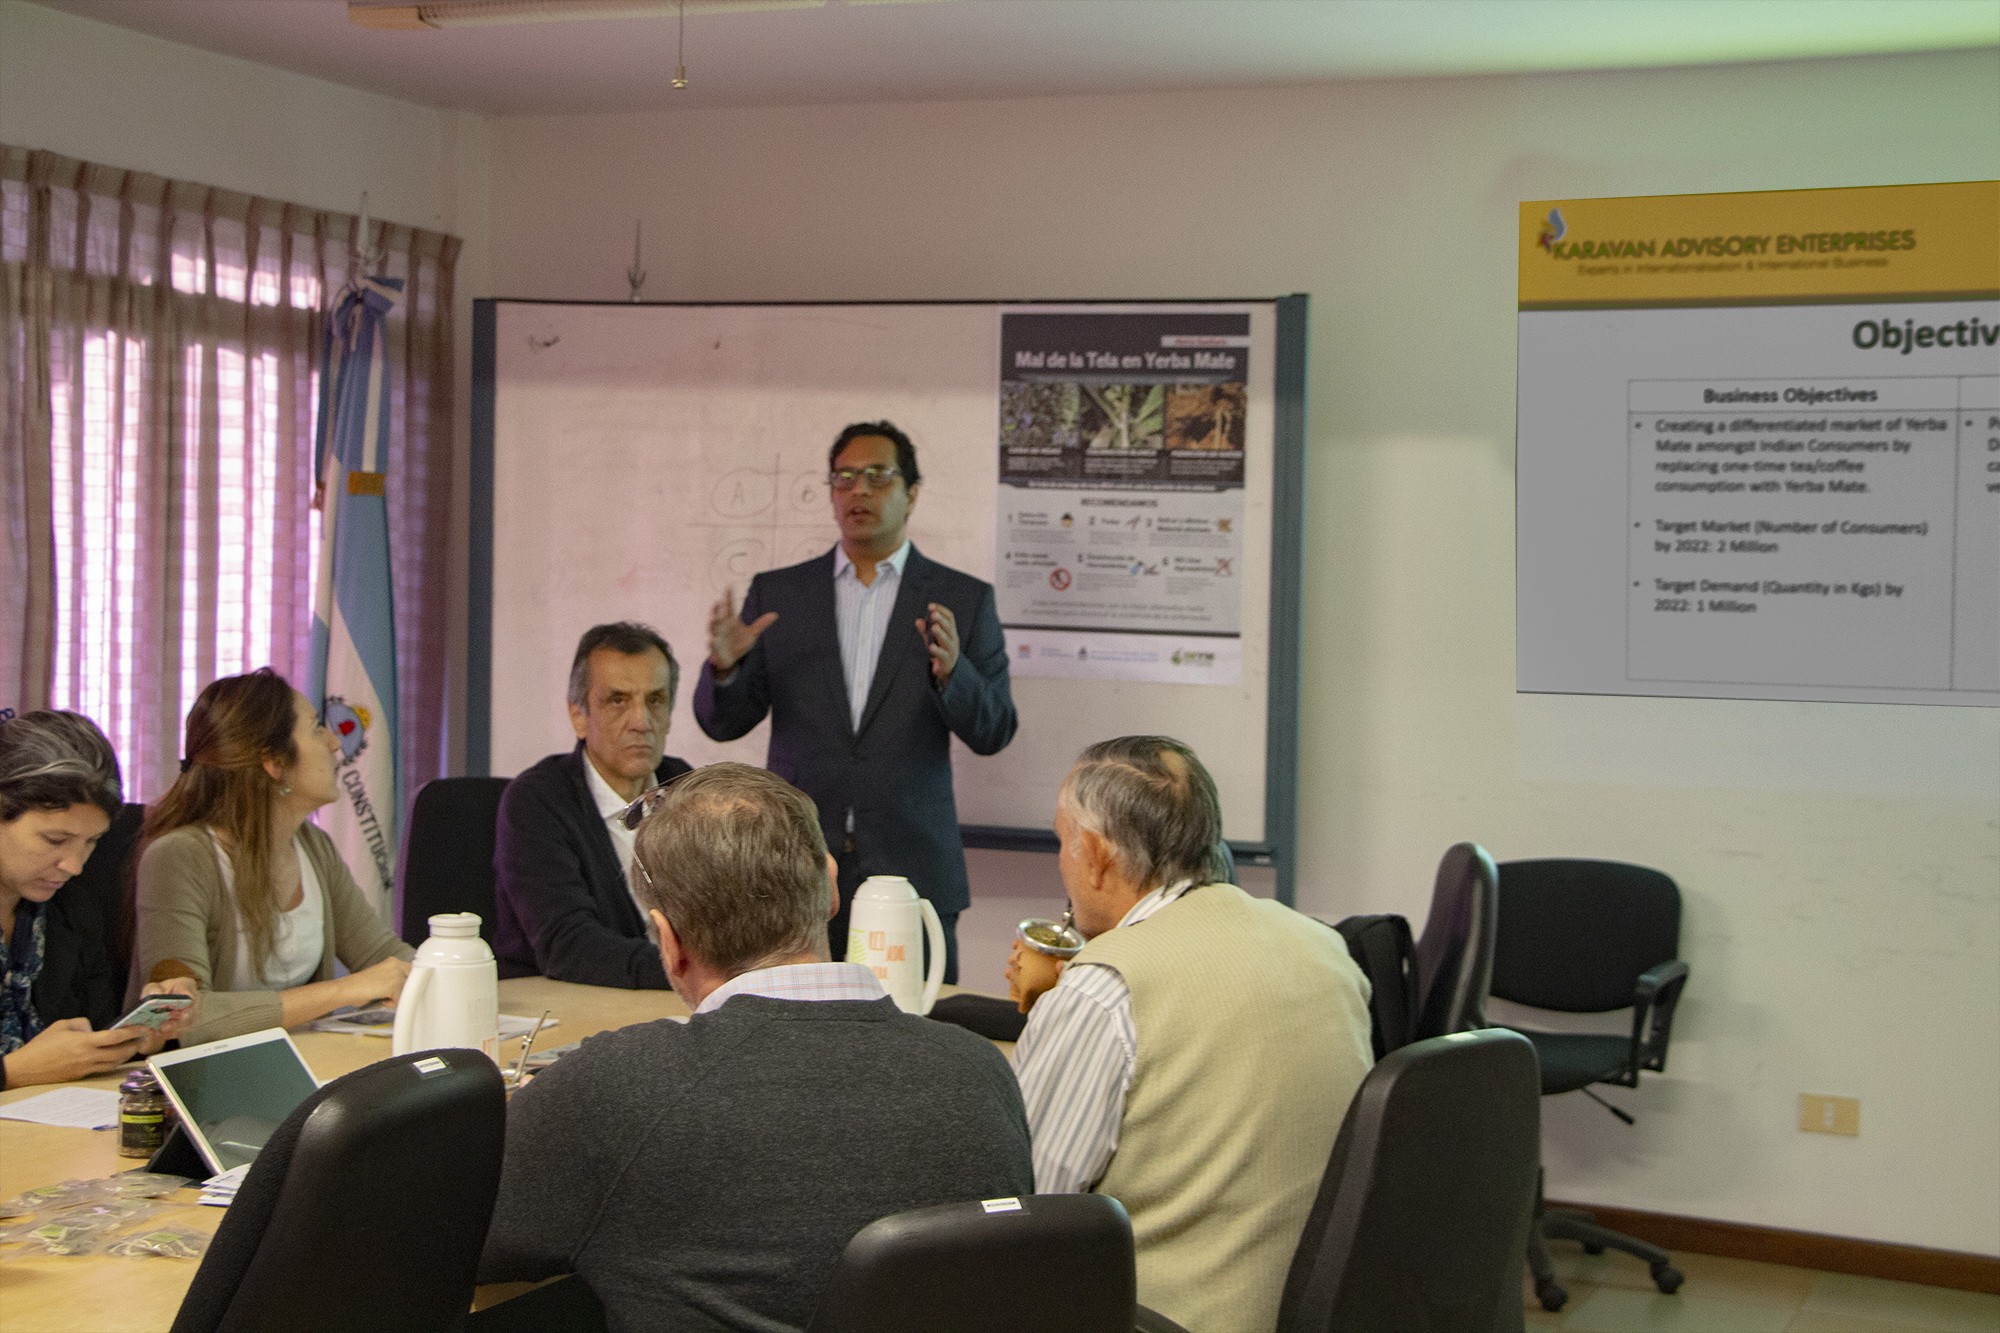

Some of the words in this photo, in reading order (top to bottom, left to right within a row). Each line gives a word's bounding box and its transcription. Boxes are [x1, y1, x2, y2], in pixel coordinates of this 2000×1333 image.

[1552, 239, 1656, 260] KARAVAN
[1660, 234, 1772, 258] ADVISORY
[1775, 228, 1917, 255] ENTERPRISES
[1047, 351, 1067, 368] de
[1069, 351, 1085, 368] la
[1143, 351, 1191, 370] Yerba
[1192, 351, 1236, 370] Mate
[1703, 387, 1779, 405] Business
[1782, 385, 1879, 406] Objectives
[1655, 418, 1714, 435] Creating
[1717, 422, 1727, 432] a
[1728, 418, 1828, 432] differentiated
[1829, 418, 1882, 432] market
[1885, 417, 1902, 431] of
[1904, 417, 1949, 432] Yerba
[1655, 438, 1692, 452] Mate
[1696, 439, 1756, 455] amongst
[1759, 438, 1804, 452] Indian
[1807, 438, 1889, 452] Consumers
[1892, 438, 1913, 454] by
[1655, 459, 1719, 476] replacing
[1721, 459, 1787, 473] one-time
[1789, 458, 1866, 474] tea/coffee
[1655, 479, 1745, 494] consumption
[1749, 479, 1781, 493] with
[1784, 479, 1825, 493] Yerba
[1655, 518, 1698, 536] Target
[1700, 519, 1751, 534] Market
[1754, 519, 1818, 536] (Number
[1821, 520, 1838, 534] of
[1840, 519, 1929, 537] Consumers)
[1654, 540, 1672, 553] by
[1729, 539, 1779, 553] Million
[1655, 578, 1697, 595] Target
[1700, 578, 1760, 594] Demand
[1762, 578, 1830, 596] (Quantity
[1833, 580, 1847, 595] in
[1884, 581, 1905, 598] by
[1707, 598, 1757, 614] Million
